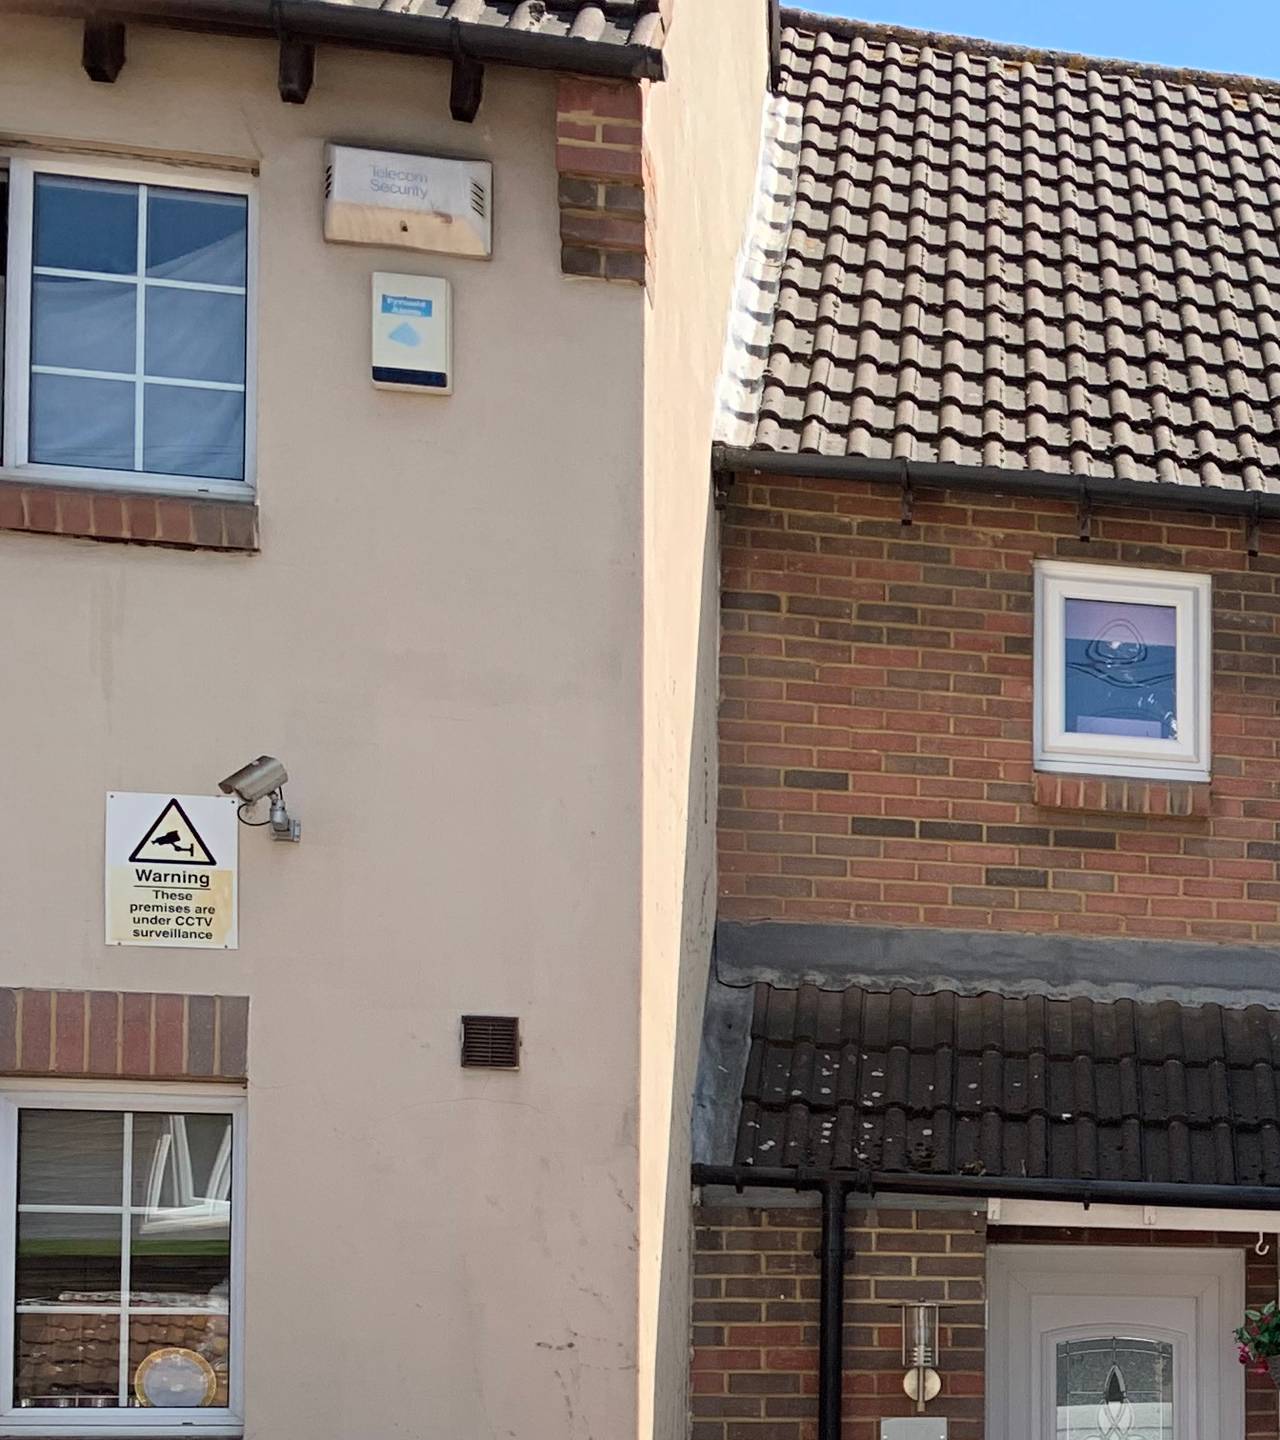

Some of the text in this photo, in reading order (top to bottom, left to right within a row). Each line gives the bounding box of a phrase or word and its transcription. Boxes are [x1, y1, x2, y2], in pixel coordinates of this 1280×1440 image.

[370, 164, 428, 183] Telecom
[370, 179, 428, 199] Security
[135, 868, 210, 887] Warning
[152, 890, 193, 900] These
[130, 903, 216, 914] premises are
[133, 916, 213, 926] under CCTV
[133, 928, 213, 939] surveillance
